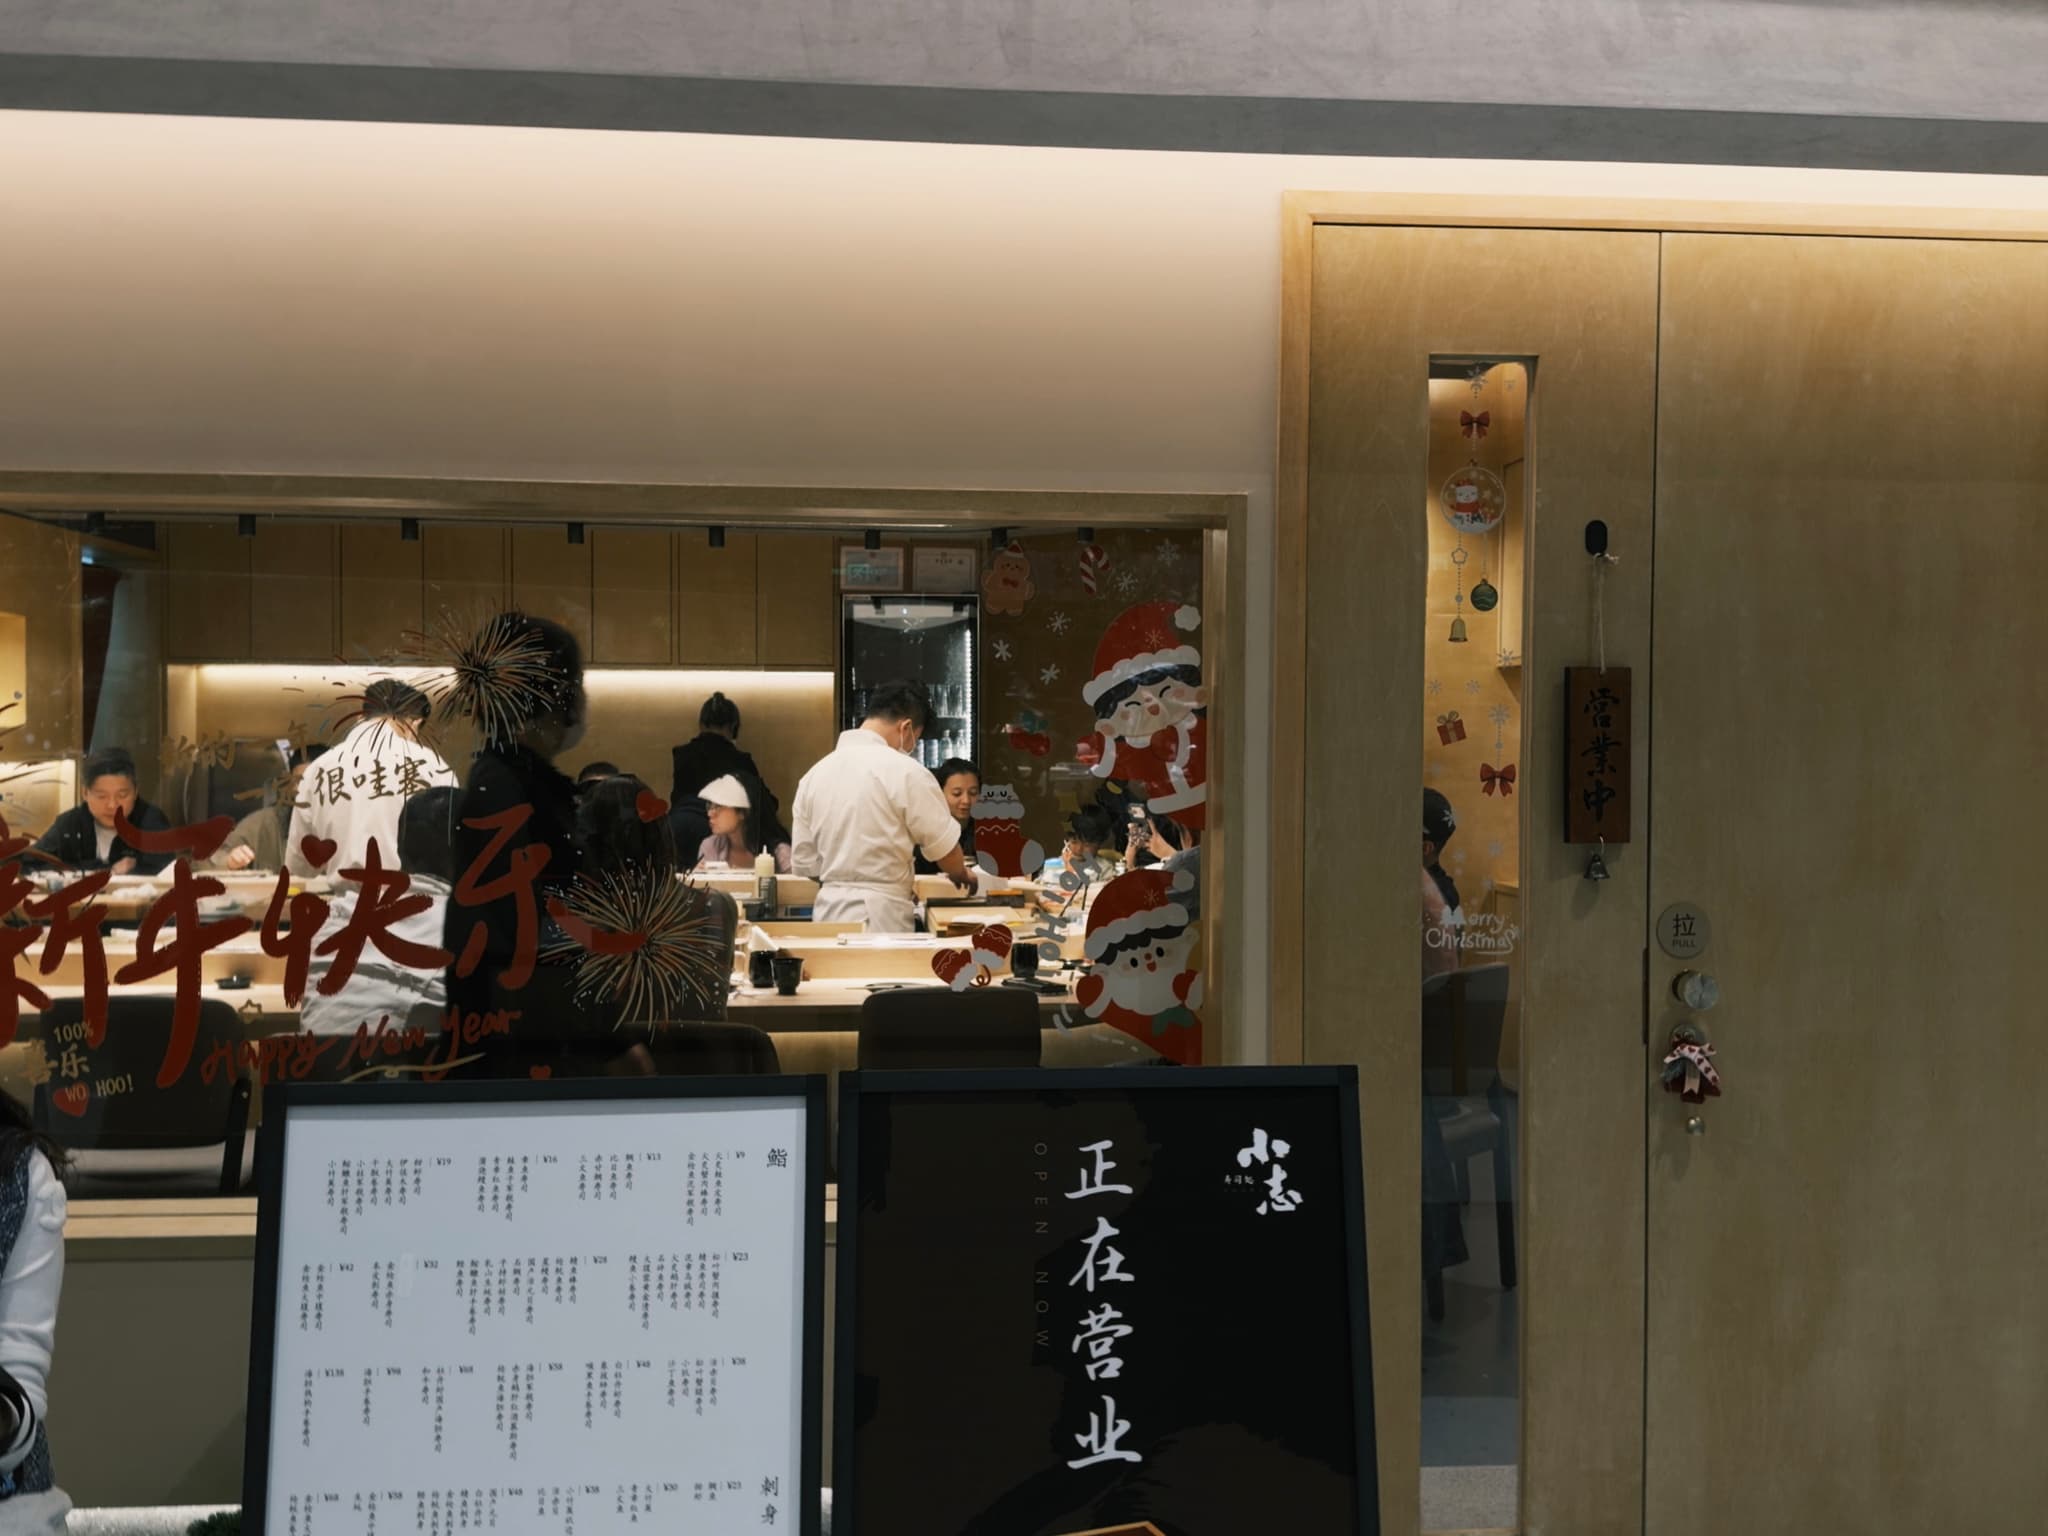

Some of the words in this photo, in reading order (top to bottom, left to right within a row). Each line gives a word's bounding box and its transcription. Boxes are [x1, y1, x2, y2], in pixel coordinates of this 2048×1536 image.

[1671, 913, 1697, 937] 拉
[1672, 939, 1697, 947] PULL
[53, 1019, 95, 1043] 100%
[65, 1086, 88, 1102] WO
[96, 1073, 135, 1097] HOO!
[1033, 1142, 1049, 1234] OPEN
[1236, 1127, 1305, 1216] 小志
[1034, 1271, 1050, 1347] NOW
[1064, 1140, 1143, 1470] 正在营业
[760, 1476, 780, 1525] 刺身
